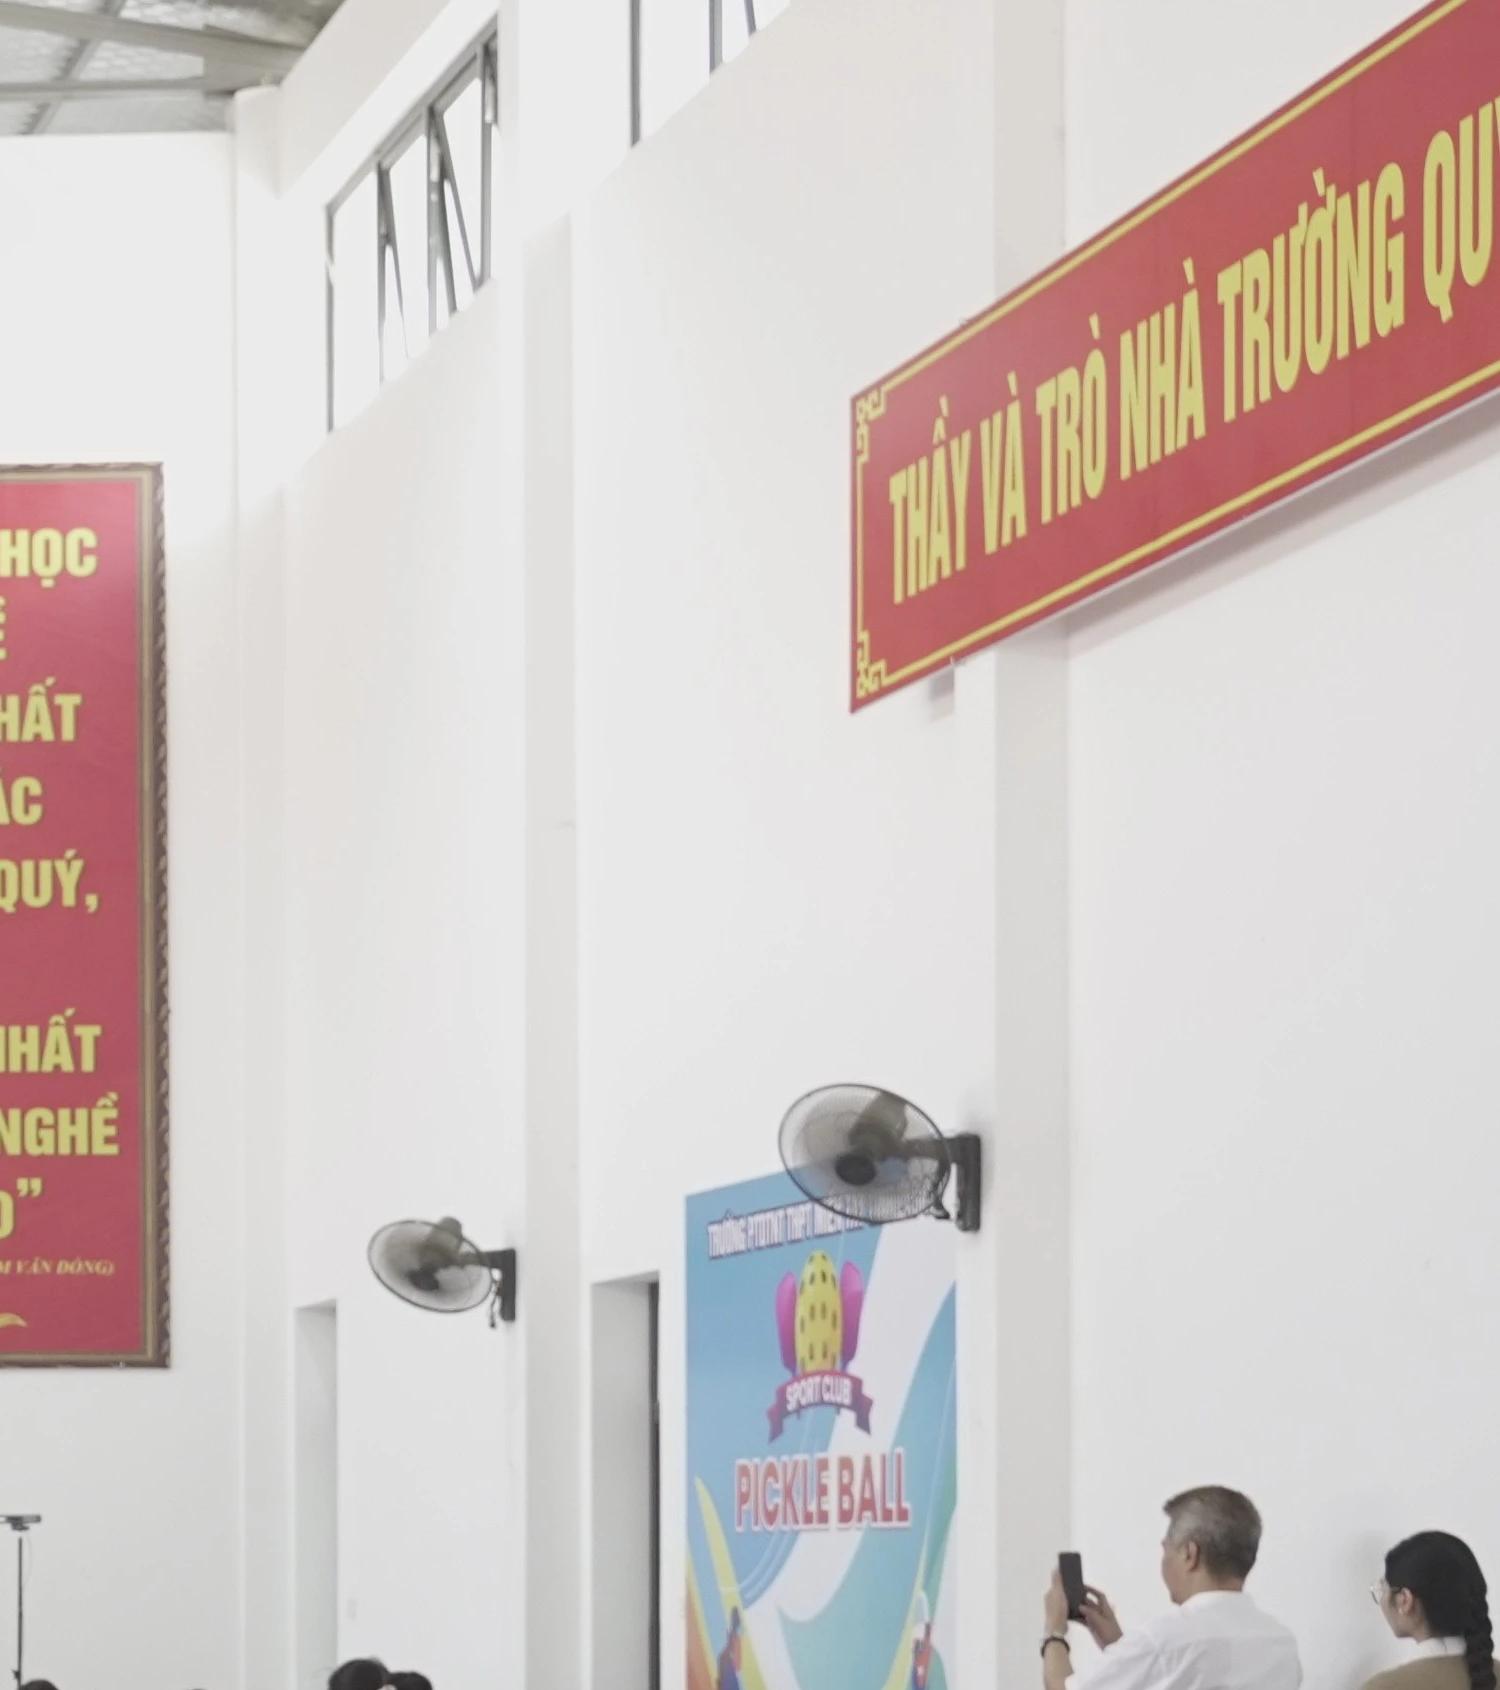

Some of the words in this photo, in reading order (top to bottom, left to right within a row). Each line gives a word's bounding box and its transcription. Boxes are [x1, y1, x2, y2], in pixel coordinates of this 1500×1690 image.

[887, 394, 974, 604] THẦY
[978, 370, 1028, 554] VÀ
[1033, 312, 1109, 524] TRÒ
[1119, 257, 1207, 480] NHÀ
[1217, 163, 1405, 422] TRƯỜNG
[1423, 96, 1500, 322] QU
[786, 1375, 821, 1411] SPORT
[822, 1374, 852, 1406] CLUB
[735, 1453, 834, 1532] PICKLE
[836, 1448, 912, 1529] BALL
